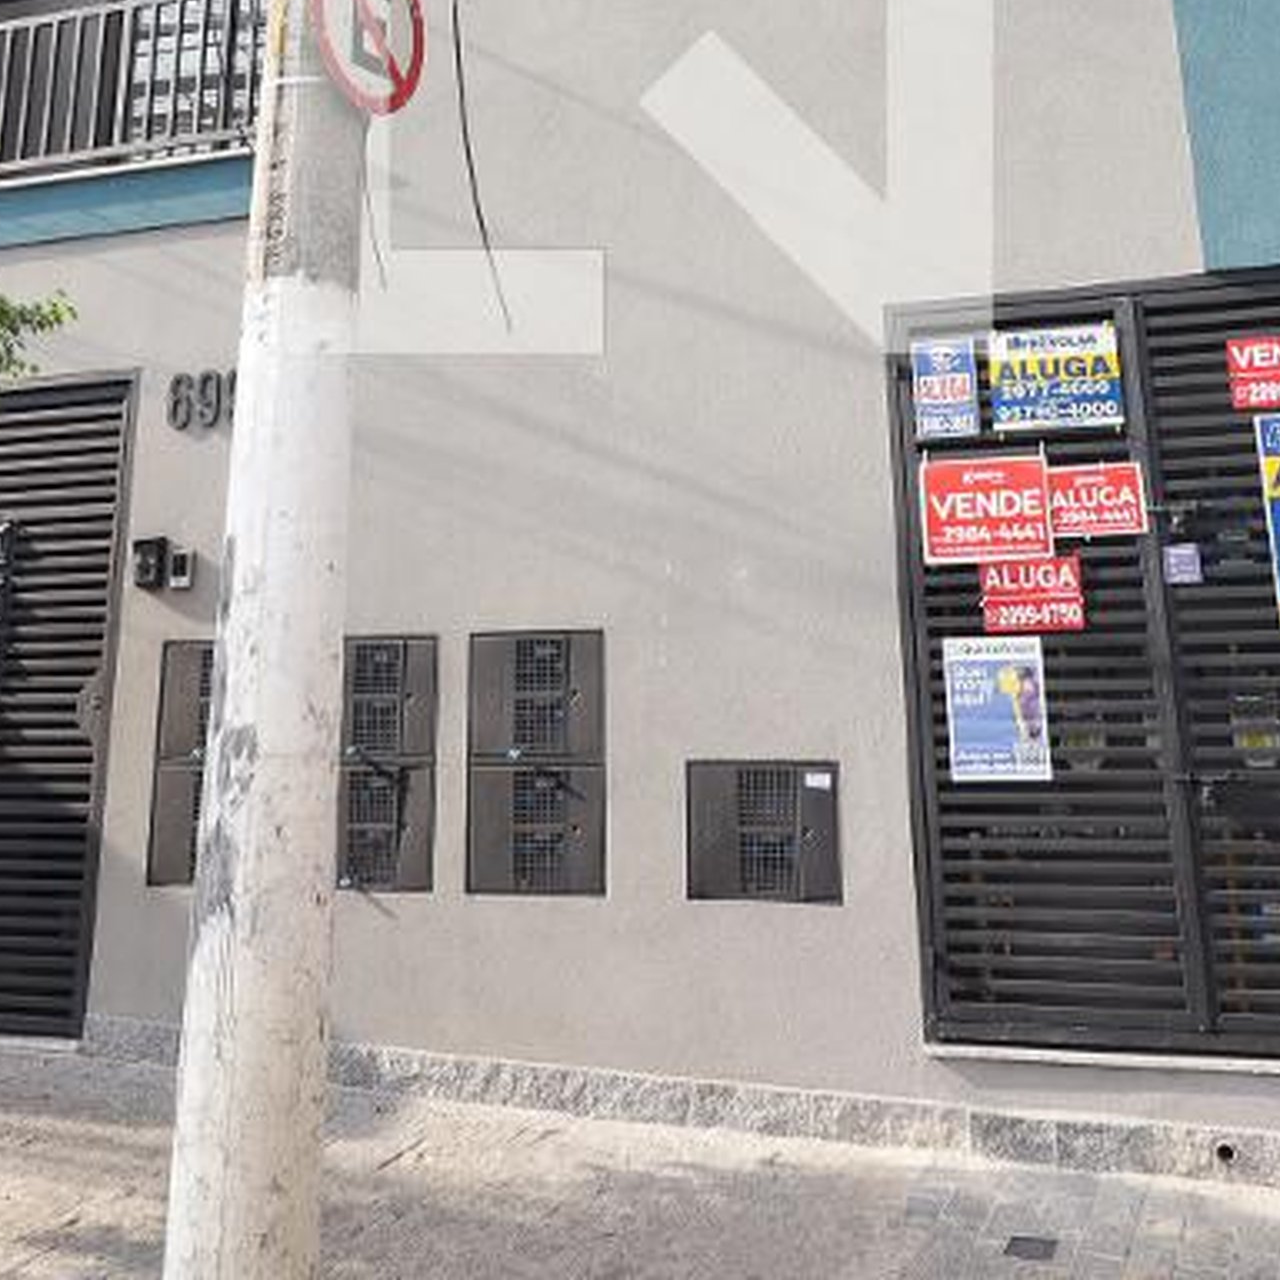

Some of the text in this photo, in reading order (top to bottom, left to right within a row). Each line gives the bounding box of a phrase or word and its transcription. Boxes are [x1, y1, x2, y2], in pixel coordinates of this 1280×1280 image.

[1000, 353, 1112, 382] ALUGA
[931, 487, 1043, 520] VENDE
[1052, 485, 1137, 510] ALUGA
[985, 563, 1078, 589] ALUGA
